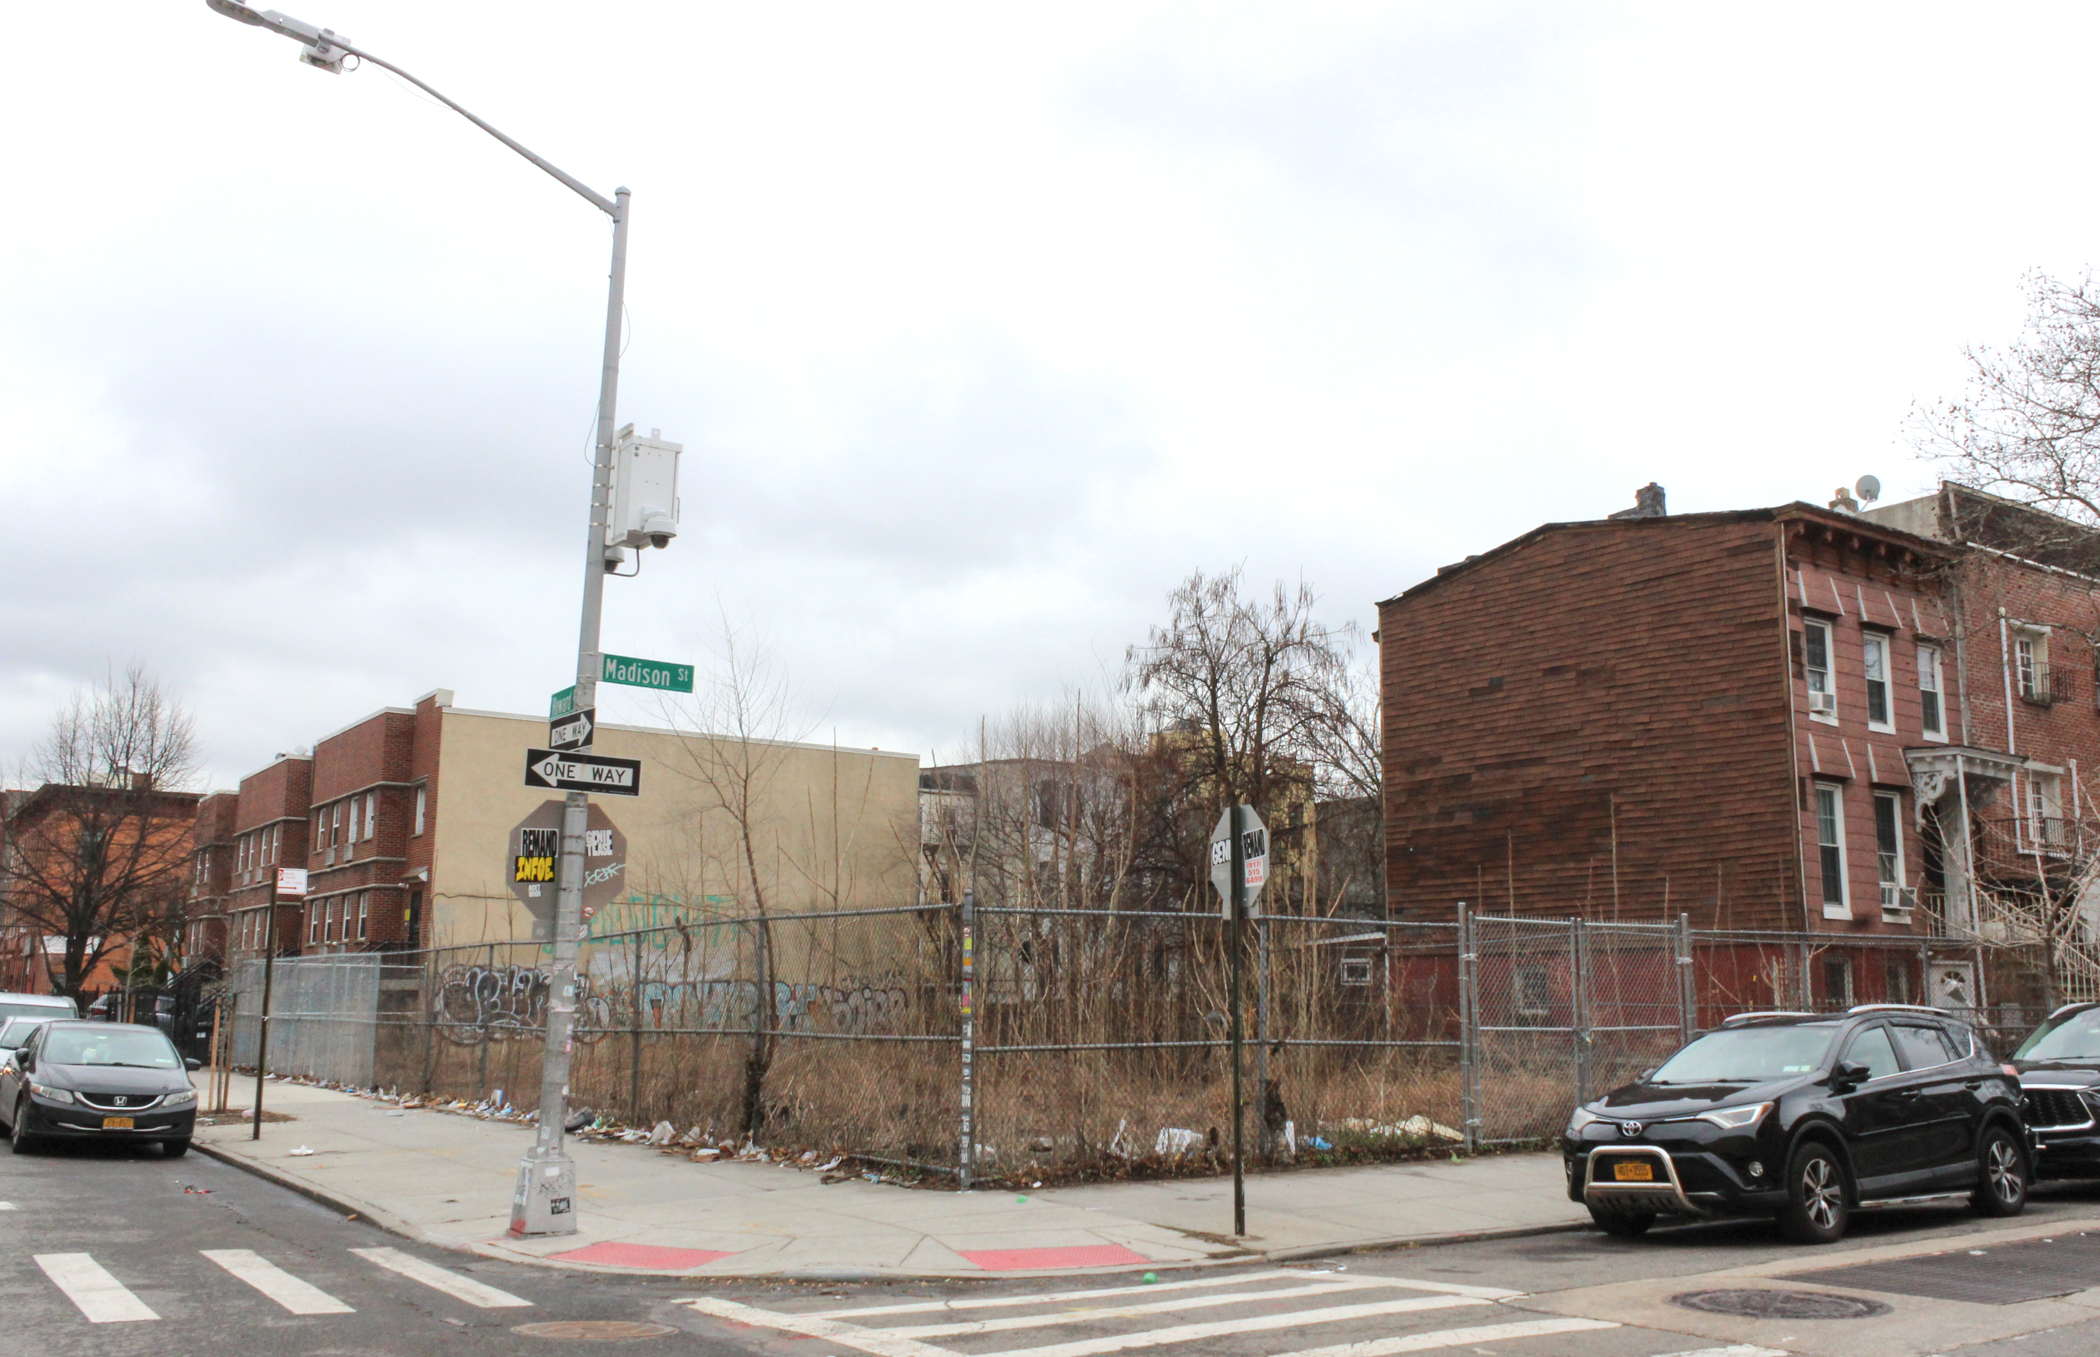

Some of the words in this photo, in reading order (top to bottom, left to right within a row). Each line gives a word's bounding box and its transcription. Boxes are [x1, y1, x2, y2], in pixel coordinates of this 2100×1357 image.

[605, 657, 671, 687] Madison
[677, 667, 689, 682] St
[554, 727, 567, 744] ONE
[571, 721, 588, 739] WAY
[543, 761, 577, 779] ONE
[592, 766, 626, 784] WAY
